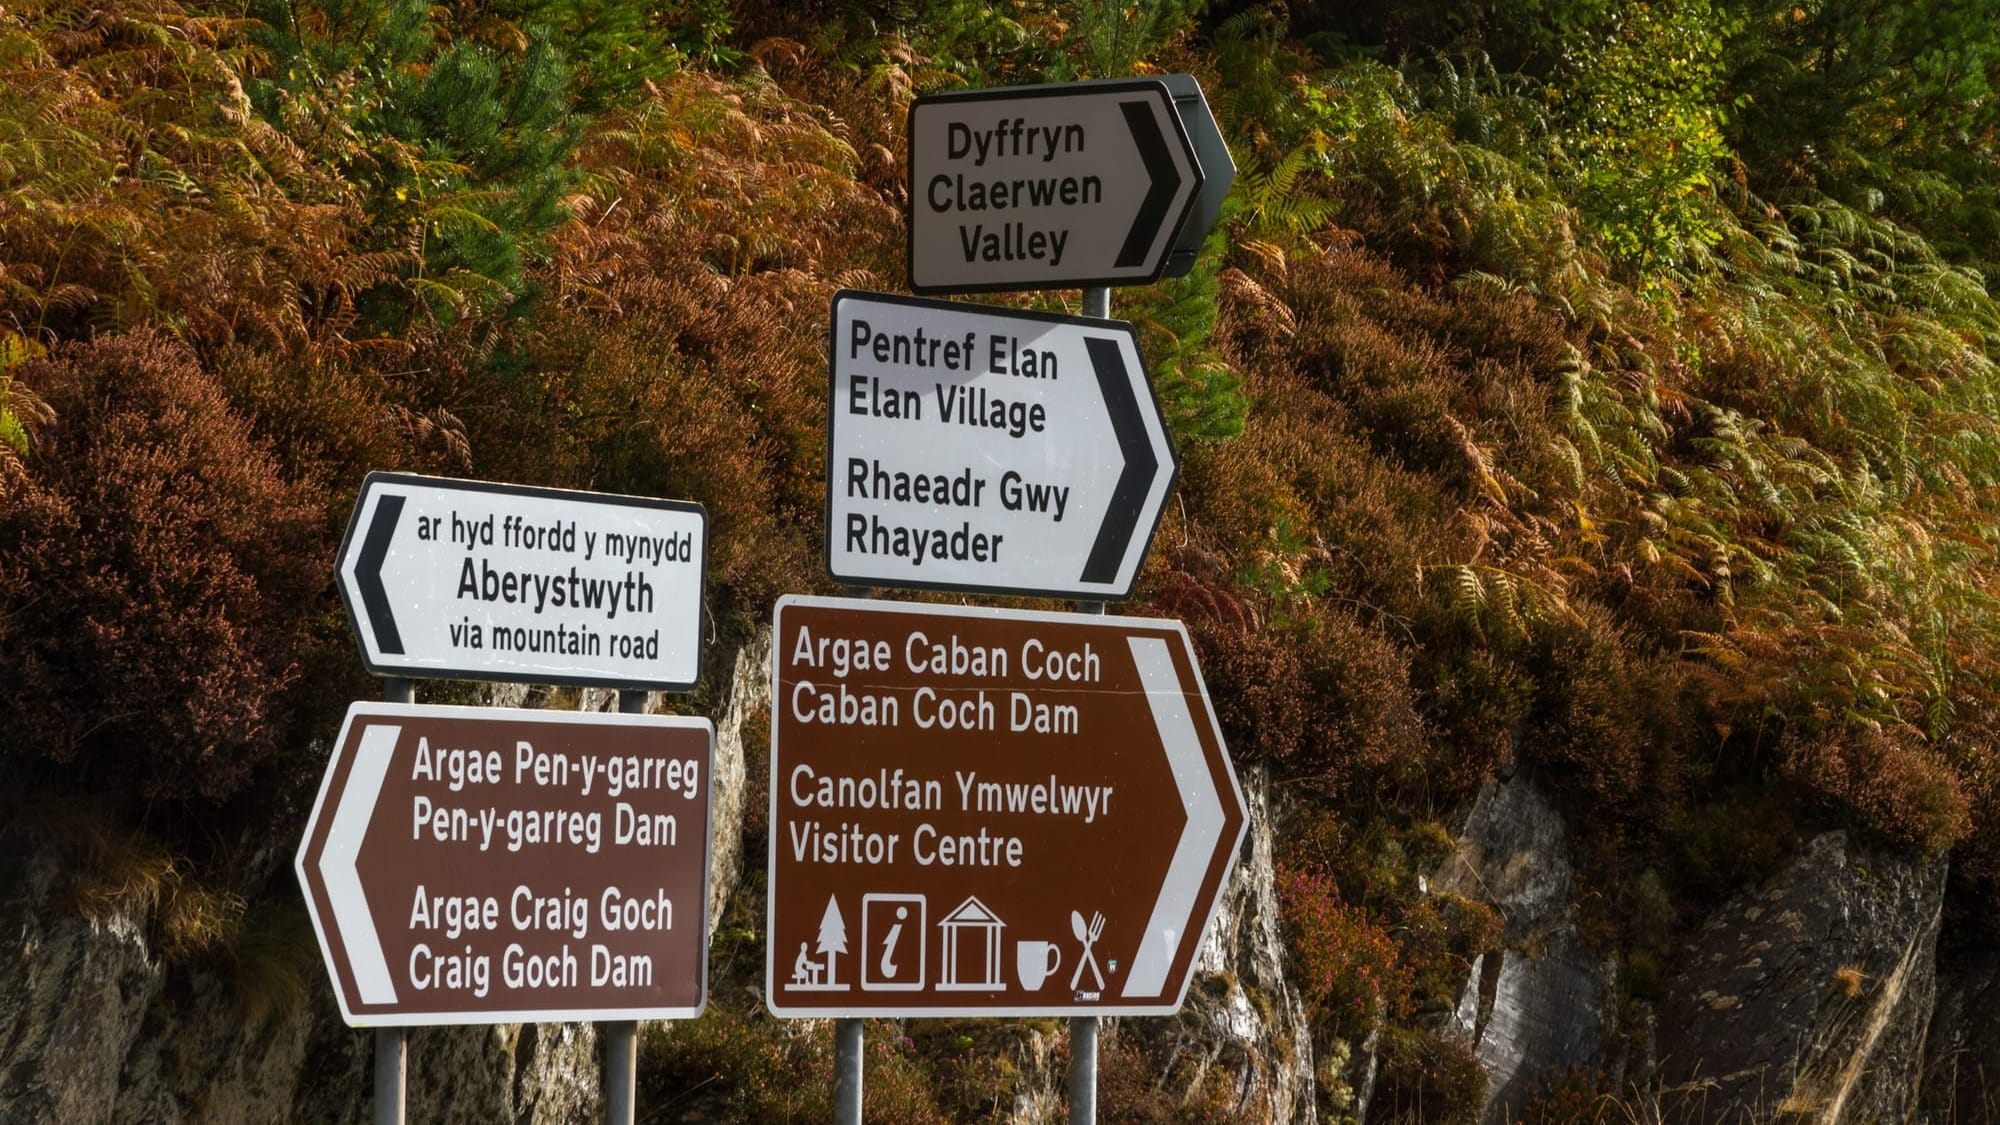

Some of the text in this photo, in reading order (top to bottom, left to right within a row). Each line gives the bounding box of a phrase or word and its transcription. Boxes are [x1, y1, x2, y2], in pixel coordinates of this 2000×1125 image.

[948, 118, 1084, 166] Dyffryn
[928, 174, 1101, 213] Claerwen
[960, 222, 1068, 266] Valley
[851, 320, 1057, 379] Pentref Elan
[850, 375, 1045, 438] Elan Village
[848, 458, 1069, 522] Rhaeadr Gwy
[418, 511, 691, 566] ar hyd ffordd y mynydd
[847, 513, 1003, 565] Rhayader
[457, 557, 653, 619] Aberystwyth
[450, 617, 658, 660] via mountain road
[792, 626, 1099, 681] Argae Caban Coch
[793, 681, 1078, 734] Caban Coch Dam
[412, 737, 698, 799] Argae Pen-y-garreg
[791, 765, 1112, 823] Canolfan Ymwelwyr
[414, 796, 676, 853] Pen-y-garreg Dam
[790, 821, 1022, 866] Visitor Centre
[410, 885, 672, 939] Argae Craig Goch
[410, 944, 651, 997] Craig Goch Dam
